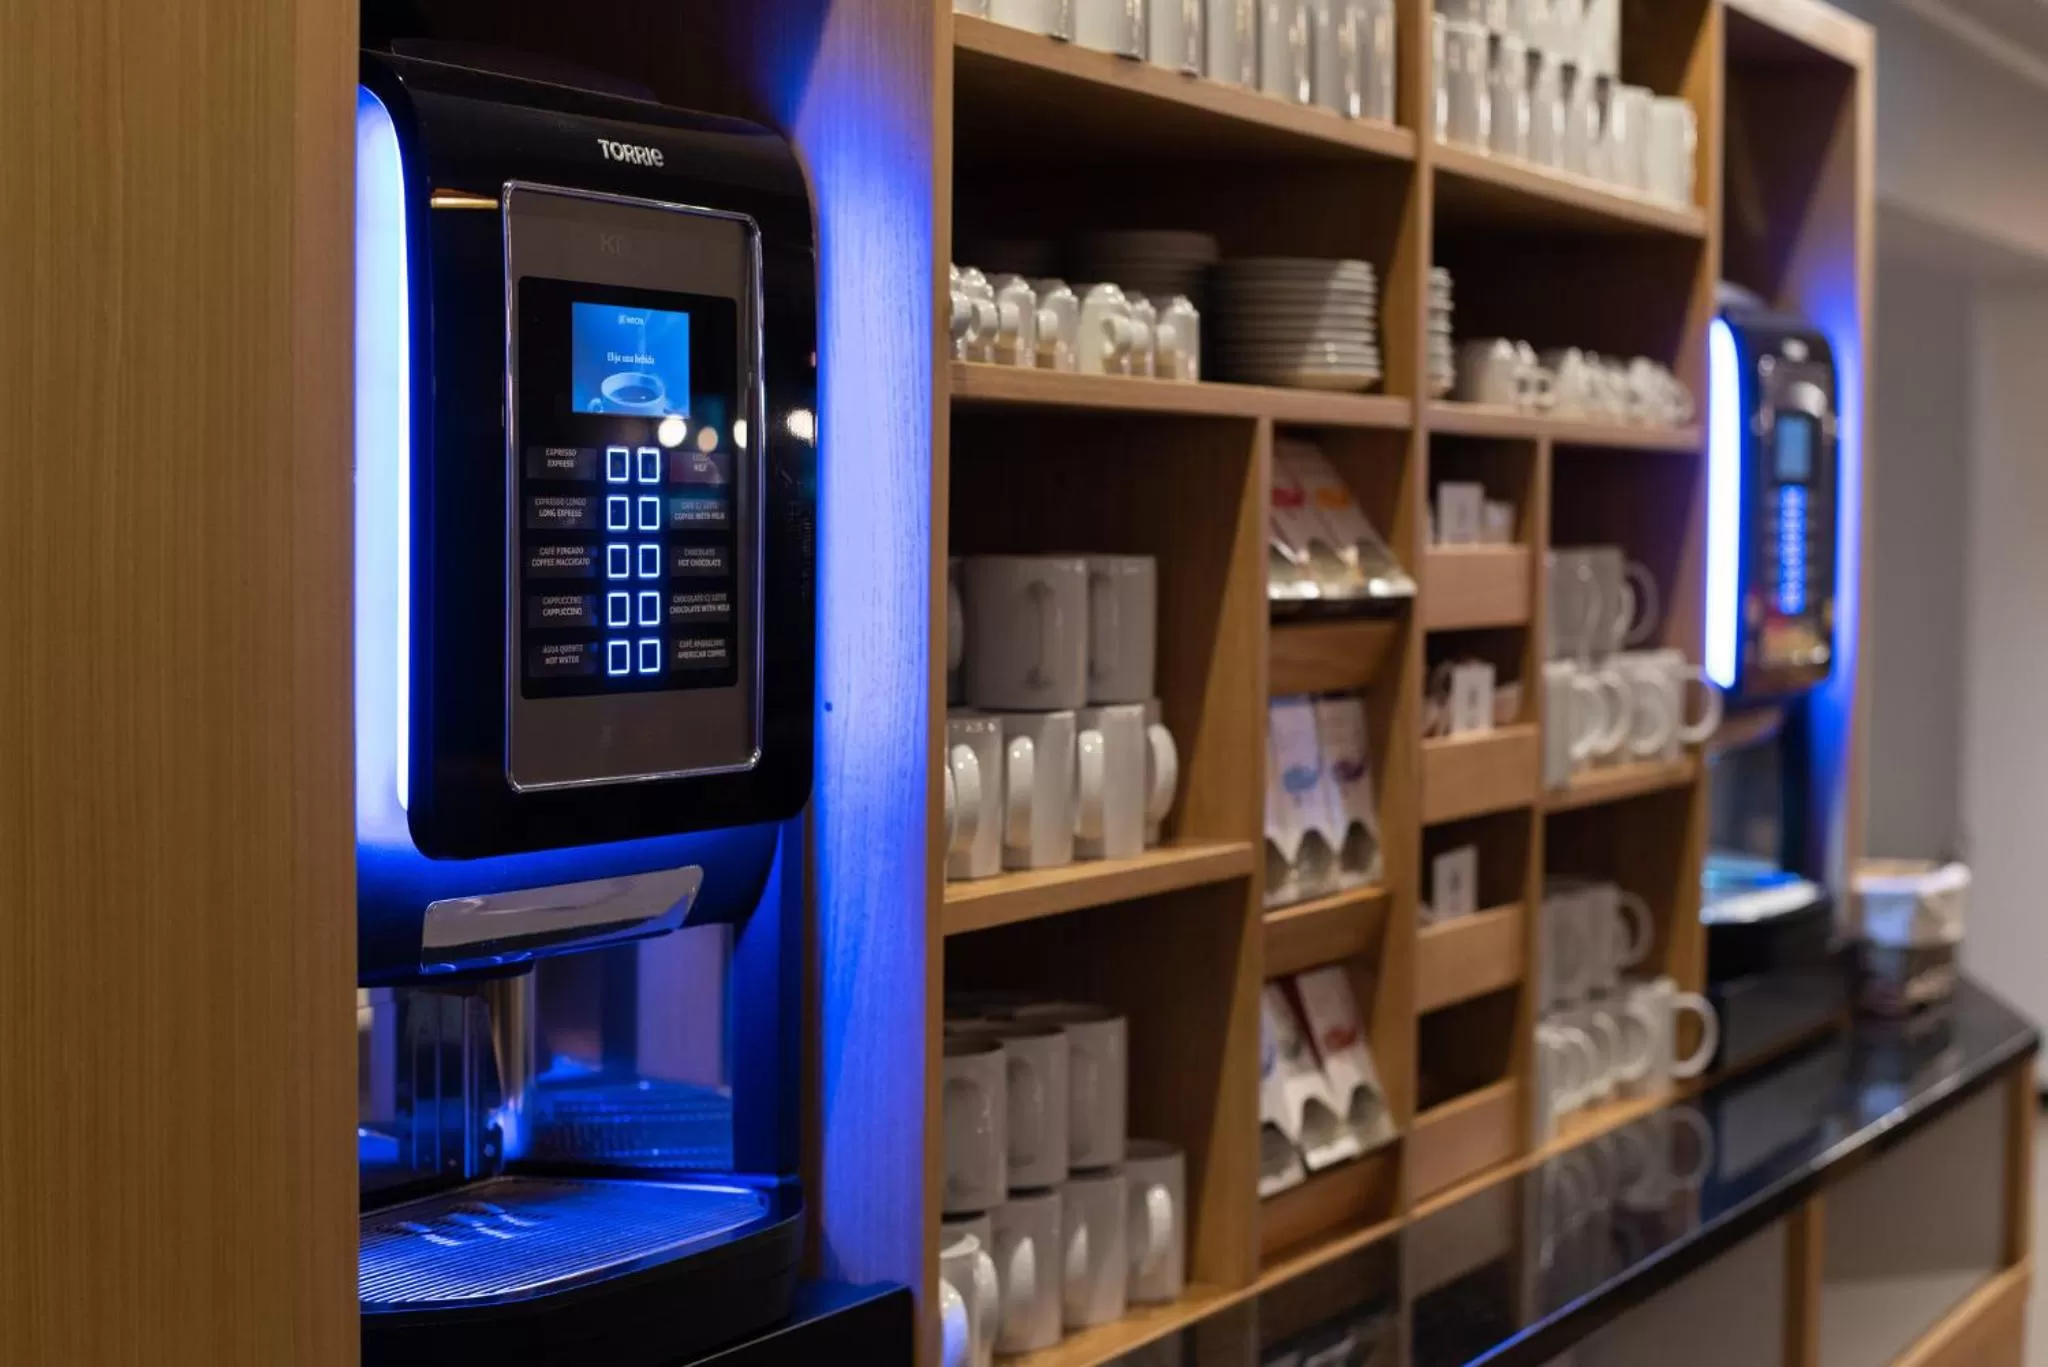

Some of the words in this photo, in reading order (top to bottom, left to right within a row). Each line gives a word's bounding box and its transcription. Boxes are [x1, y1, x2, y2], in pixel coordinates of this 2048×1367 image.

[531, 558, 554, 568] COFFEE
[690, 559, 722, 567] CHOCOLATE
[542, 608, 583, 616] CAPPUCCINO
